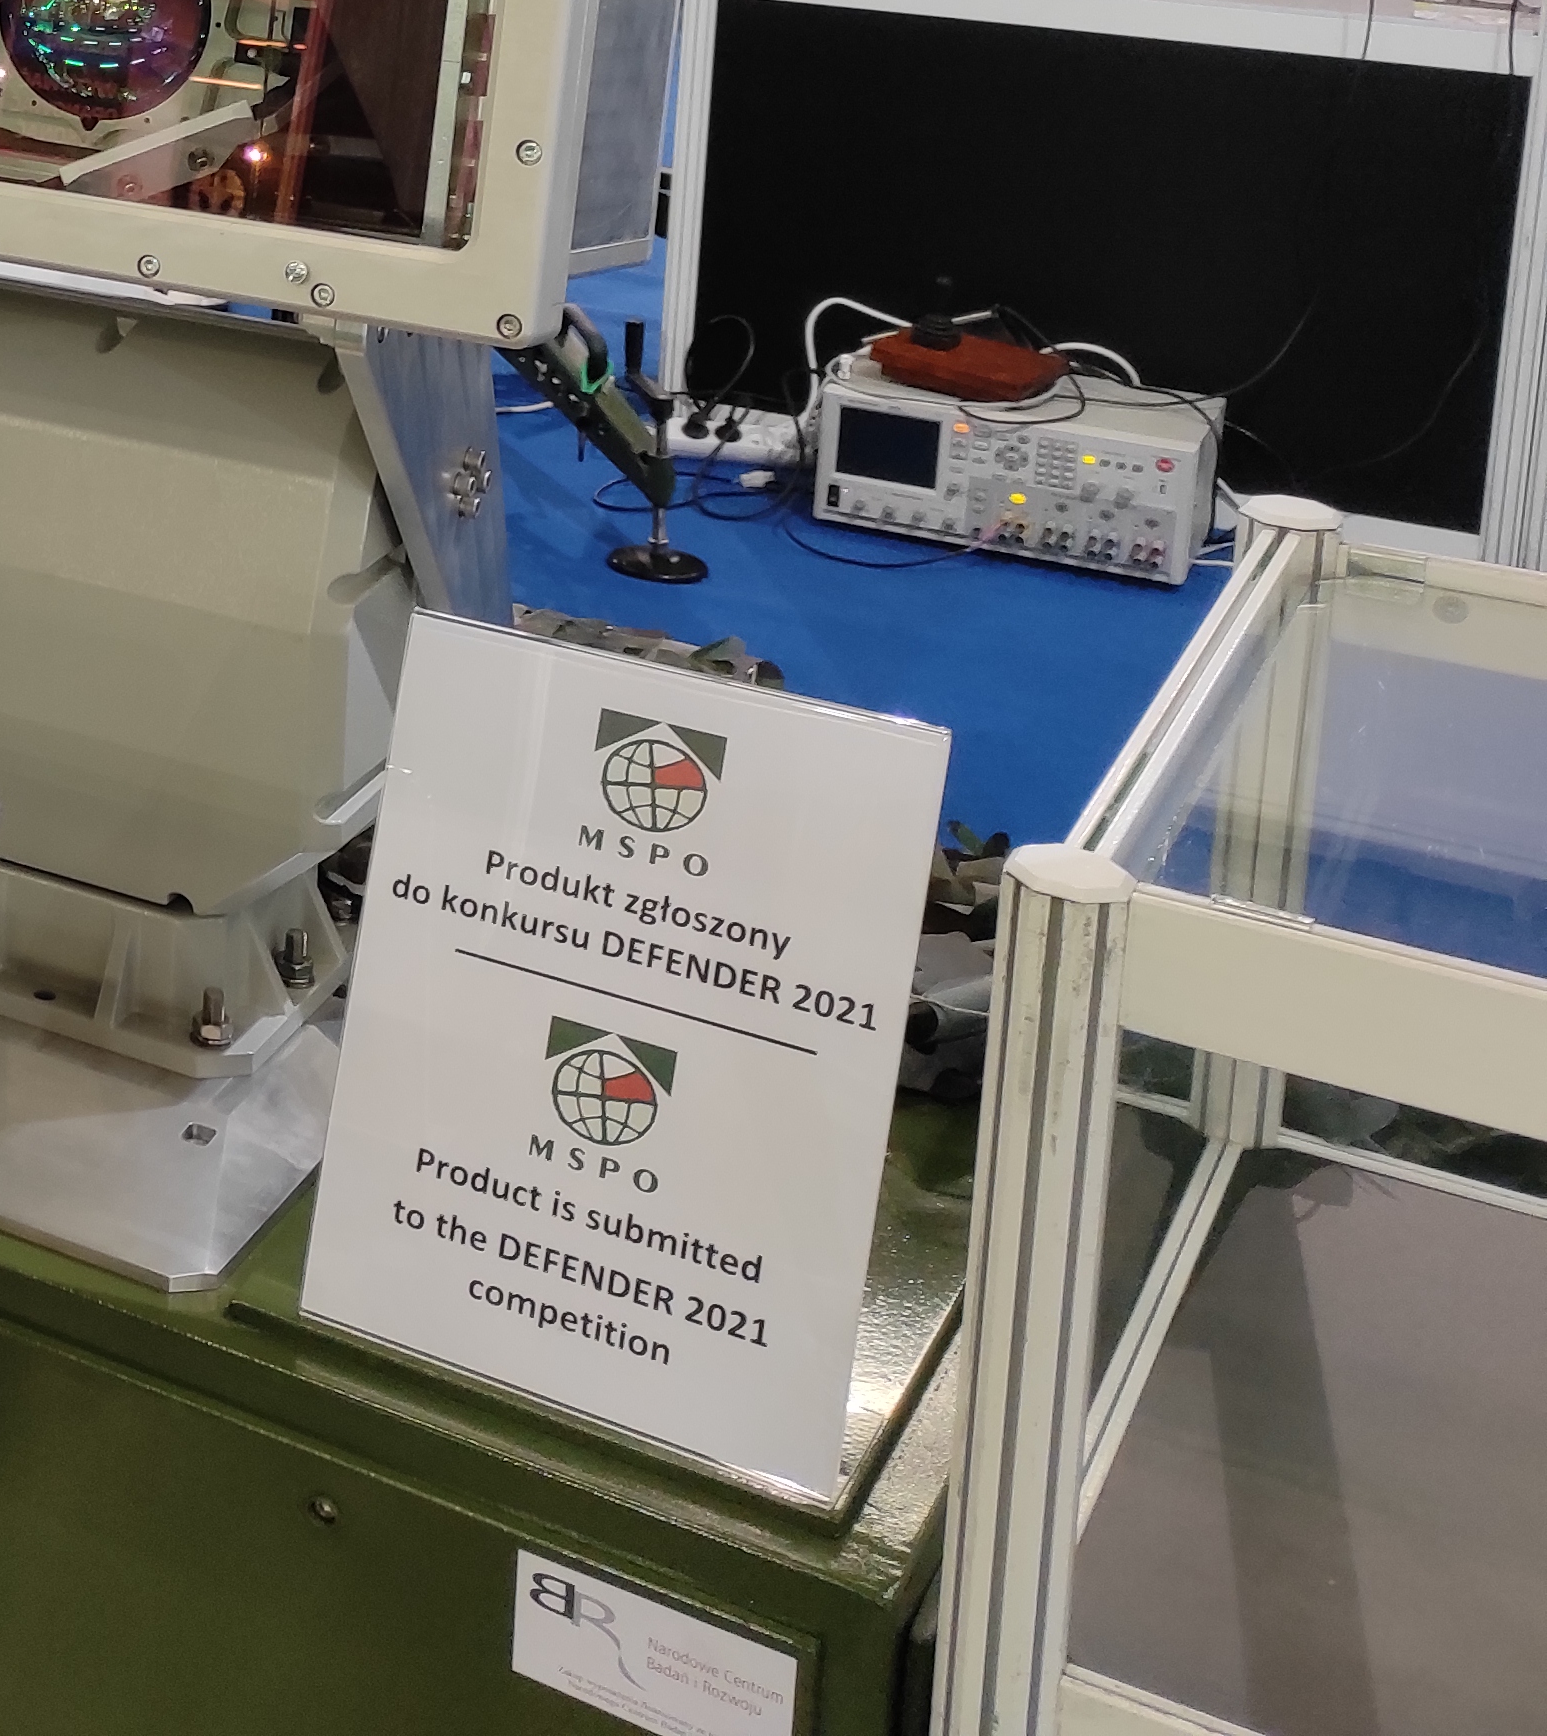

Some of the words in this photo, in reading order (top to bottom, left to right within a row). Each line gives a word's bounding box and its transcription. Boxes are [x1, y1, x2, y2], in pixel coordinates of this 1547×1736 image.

[392, 874, 431, 905] do
[441, 884, 590, 951] konkursu
[602, 930, 782, 1005] DEFENDER
[792, 983, 878, 1031] 2021
[486, 850, 615, 908] Produkt
[624, 888, 792, 960] zgłoszony
[416, 1148, 542, 1212] Product
[552, 1190, 575, 1222] is
[586, 1208, 763, 1284] submitted
[394, 1200, 425, 1231] to
[437, 1213, 487, 1252] the
[499, 1233, 674, 1315] DEFENDER
[685, 1296, 769, 1348] 2021
[469, 1277, 670, 1365] competition
[646, 1656, 690, 1685] Badań
[702, 1680, 764, 1718] Rozwoju
[647, 1637, 719, 1678] Narodowe
[724, 1669, 784, 1705] Centrum
